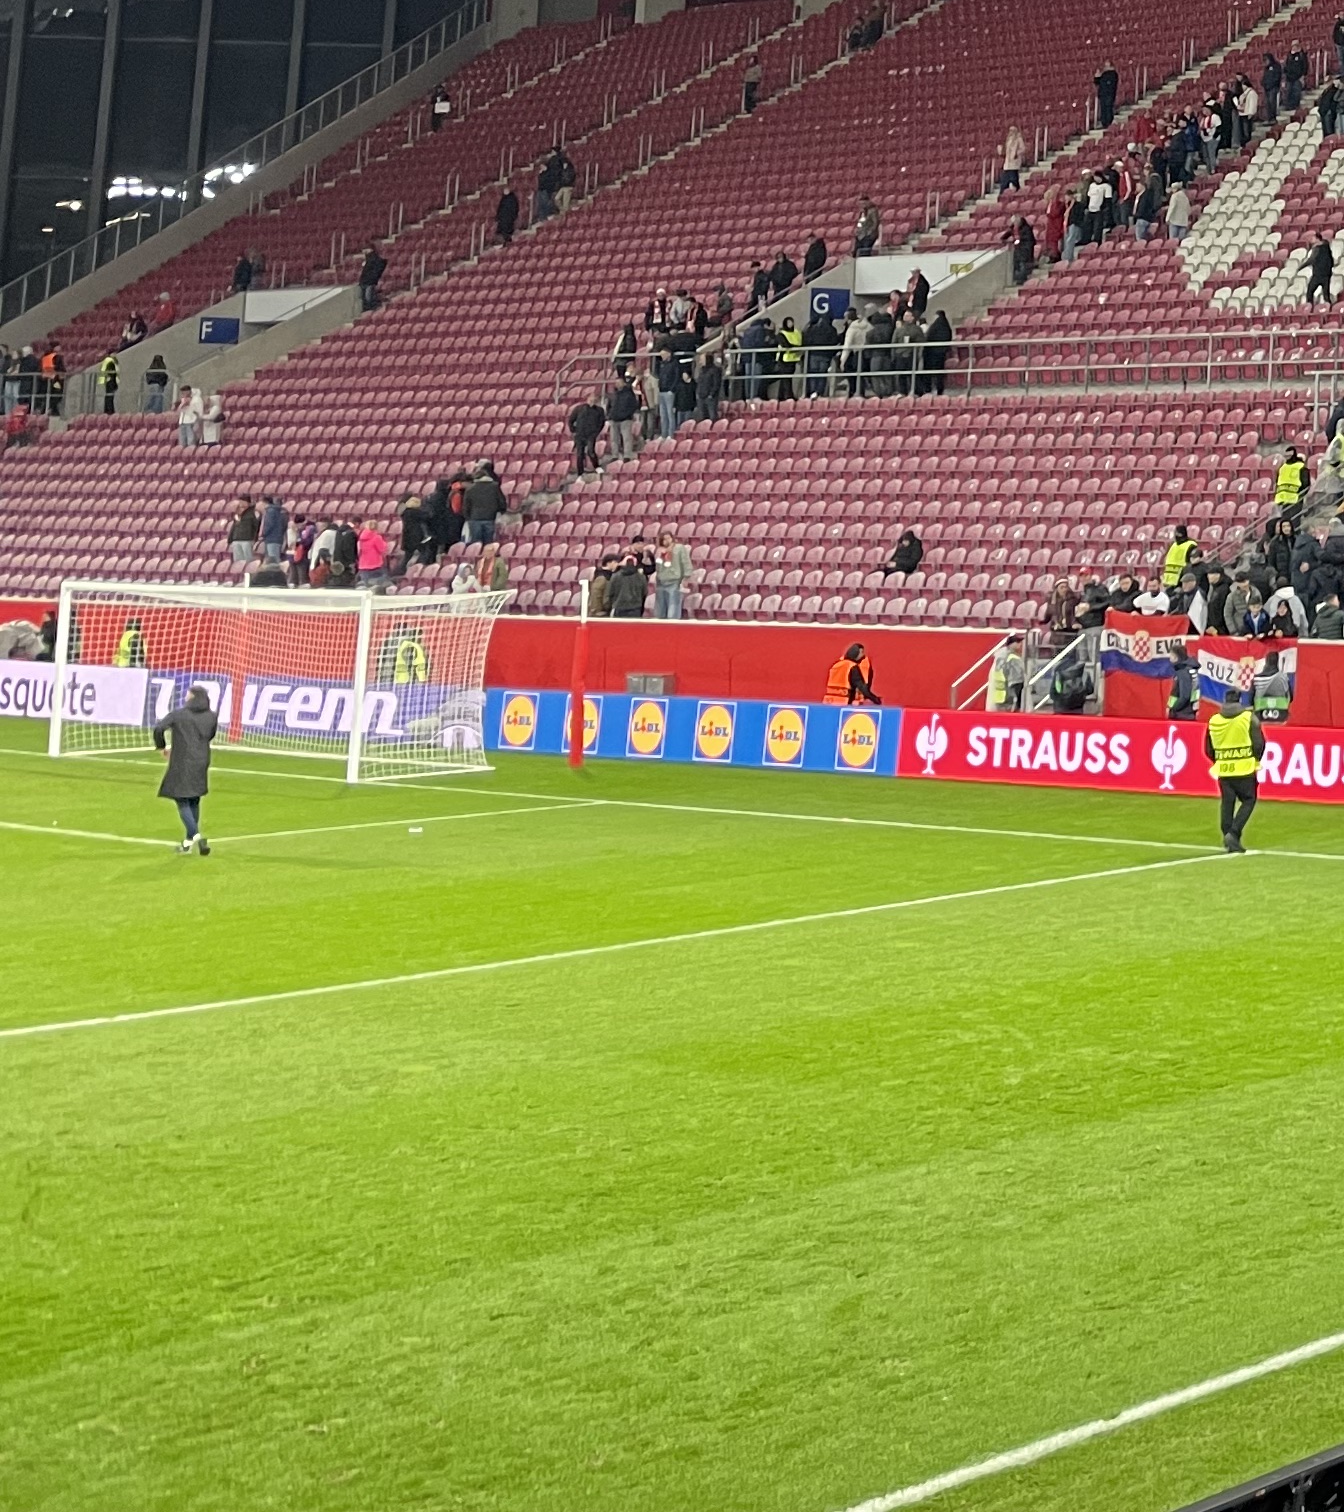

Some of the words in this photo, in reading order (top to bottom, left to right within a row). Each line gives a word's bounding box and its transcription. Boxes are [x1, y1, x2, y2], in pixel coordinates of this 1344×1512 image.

[812, 293, 830, 315] G
[201, 321, 213, 340] F
[1206, 661, 1234, 684] RUŽ
[966, 726, 1131, 775] STRAUSS
